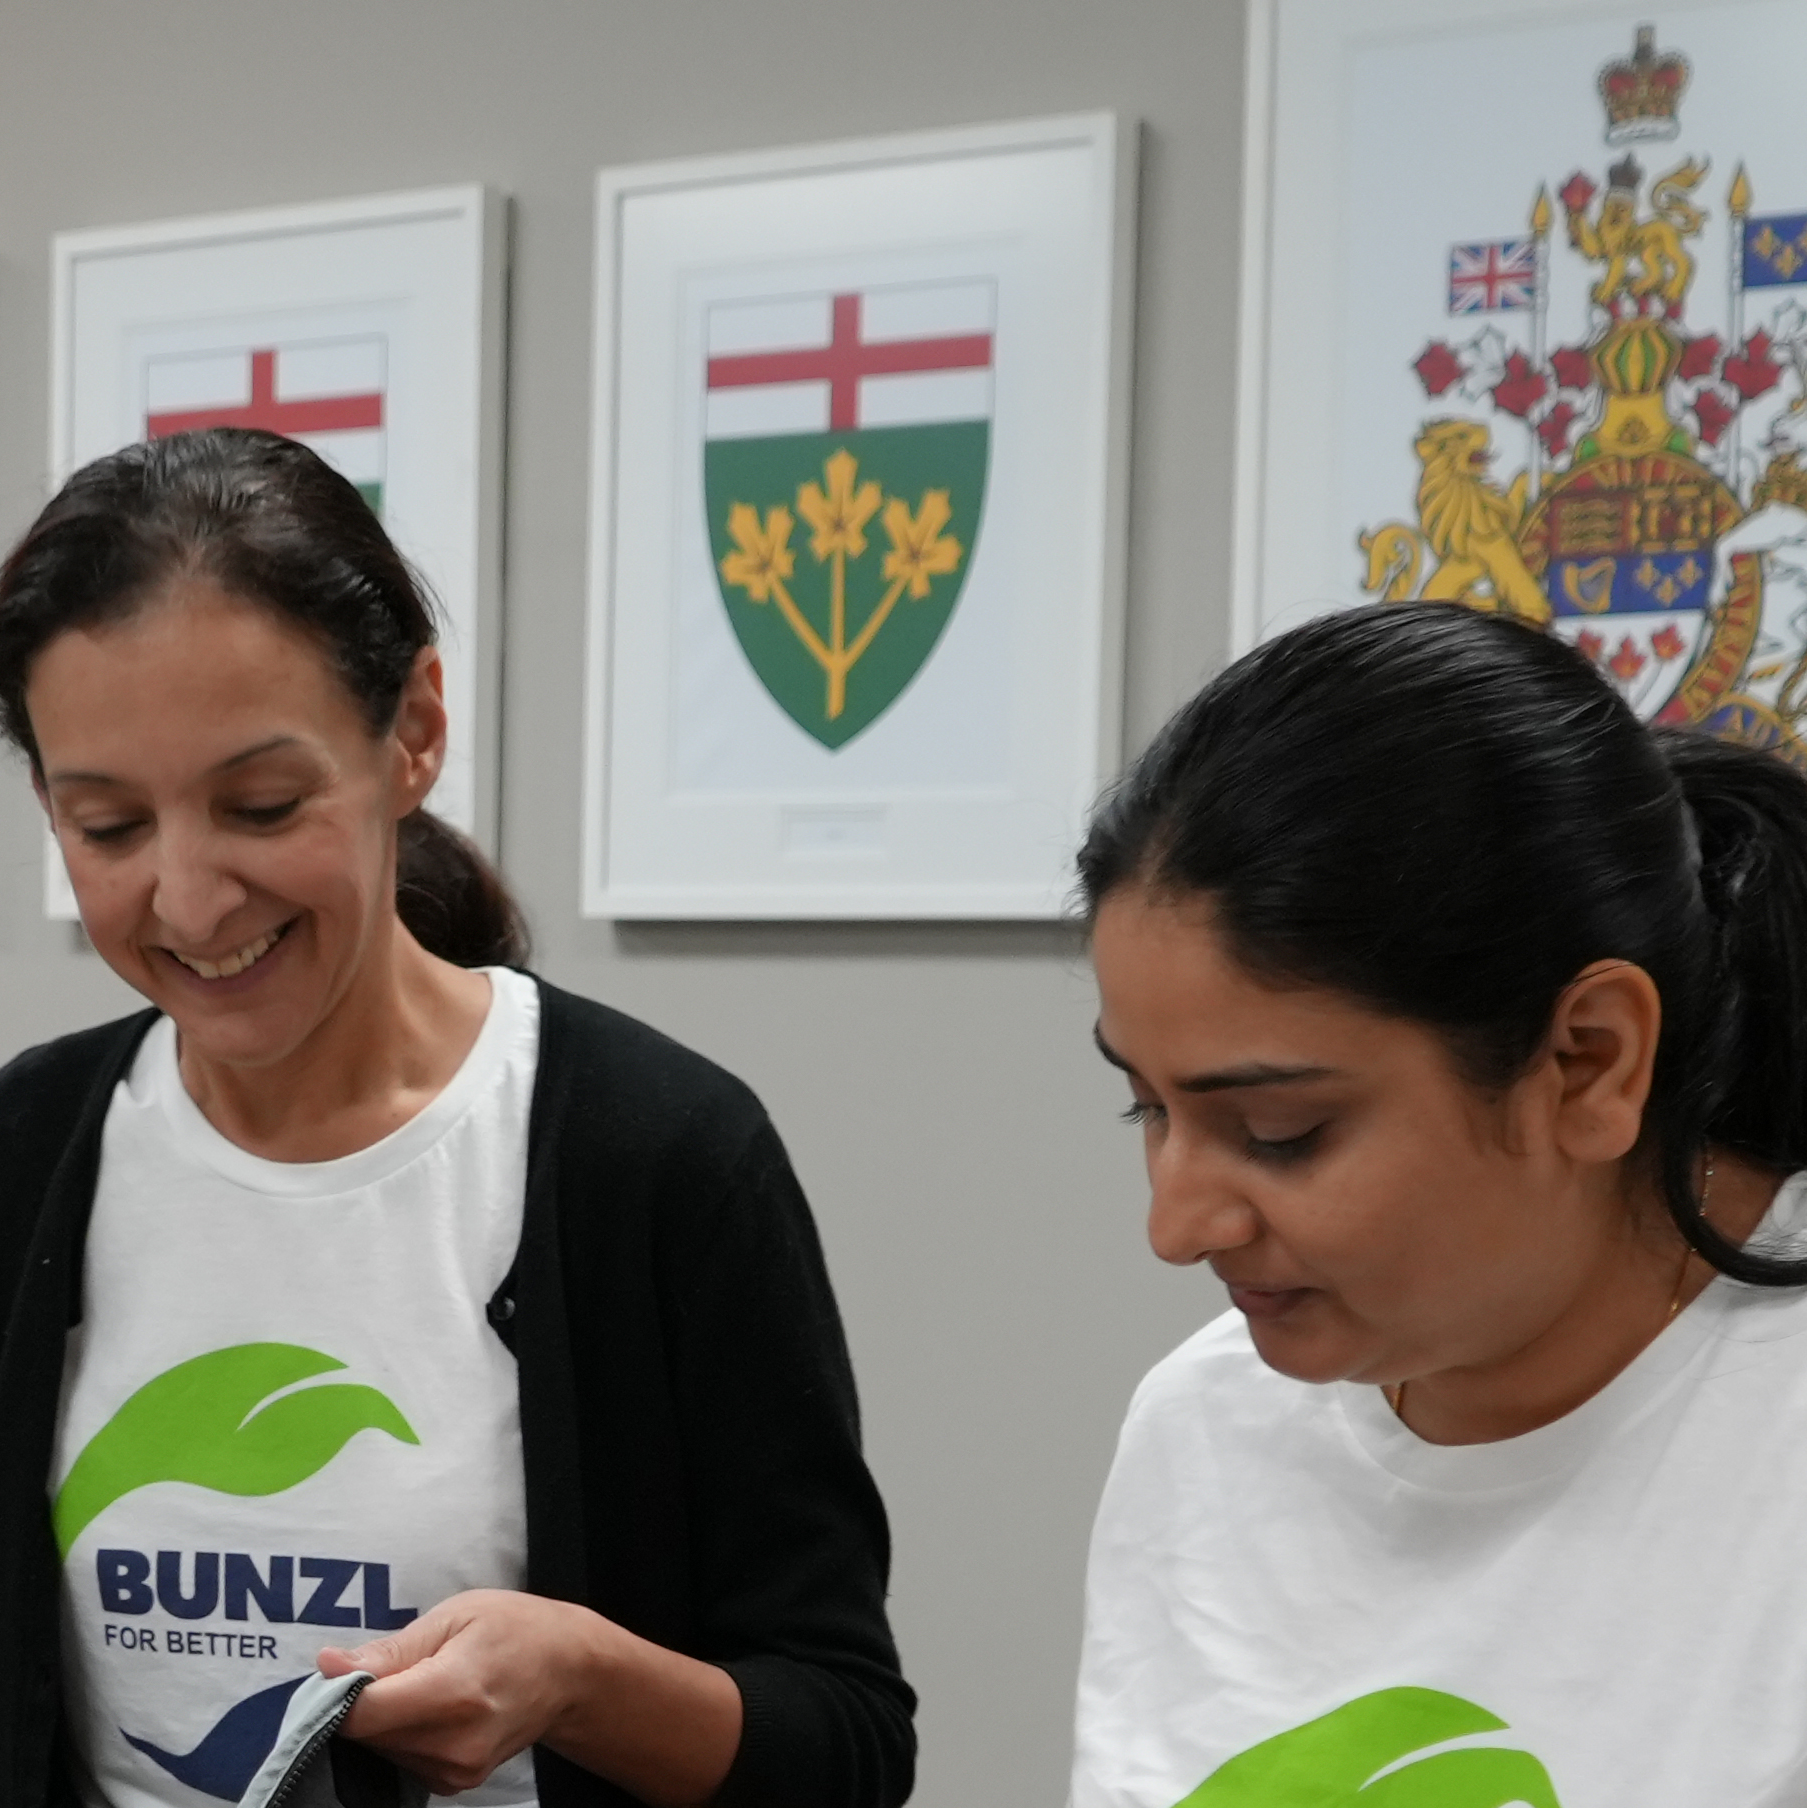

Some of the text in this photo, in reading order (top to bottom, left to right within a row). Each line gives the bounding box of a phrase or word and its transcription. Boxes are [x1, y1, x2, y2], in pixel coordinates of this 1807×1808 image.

[97, 1548, 419, 1631] BUNZL
[104, 1624, 279, 1660] FOR BETTER
